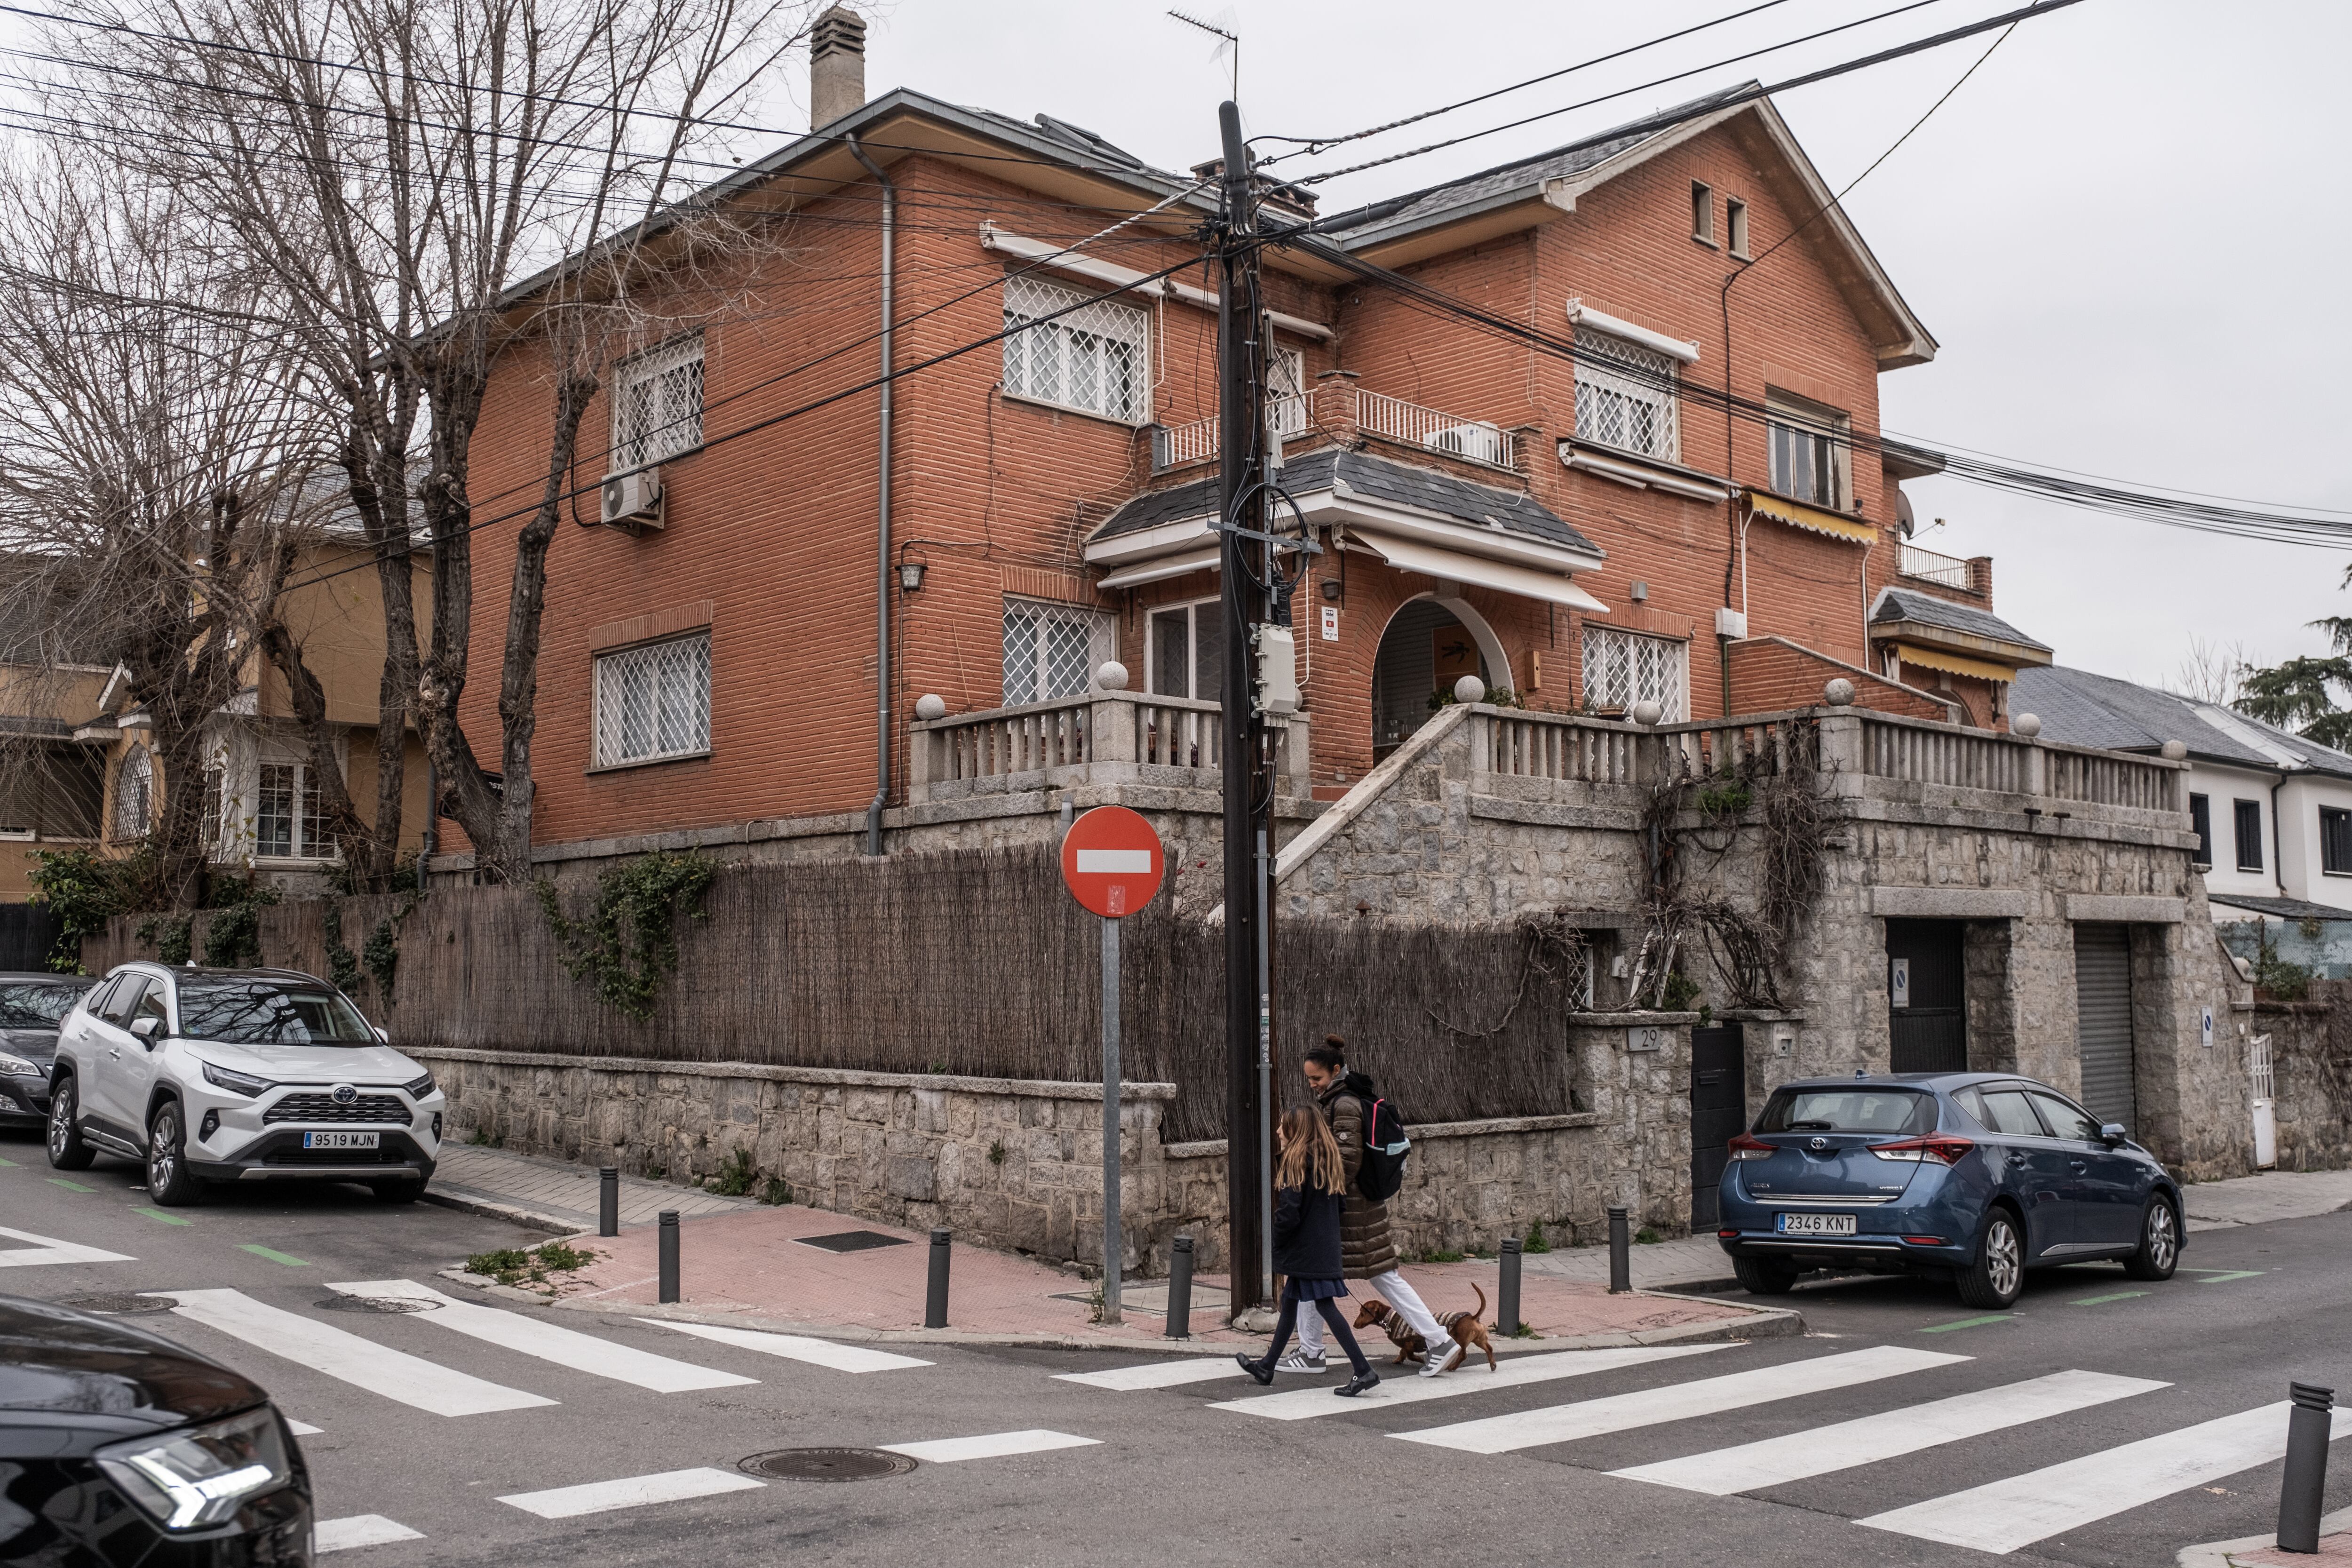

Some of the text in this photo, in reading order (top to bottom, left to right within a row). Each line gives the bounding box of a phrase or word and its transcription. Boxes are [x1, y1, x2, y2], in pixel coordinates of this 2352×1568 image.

[1642, 1029, 1657, 1047] 29
[315, 1134, 374, 1146] 9519 MJN
[1787, 1216, 1853, 1231] 2346 KNT
